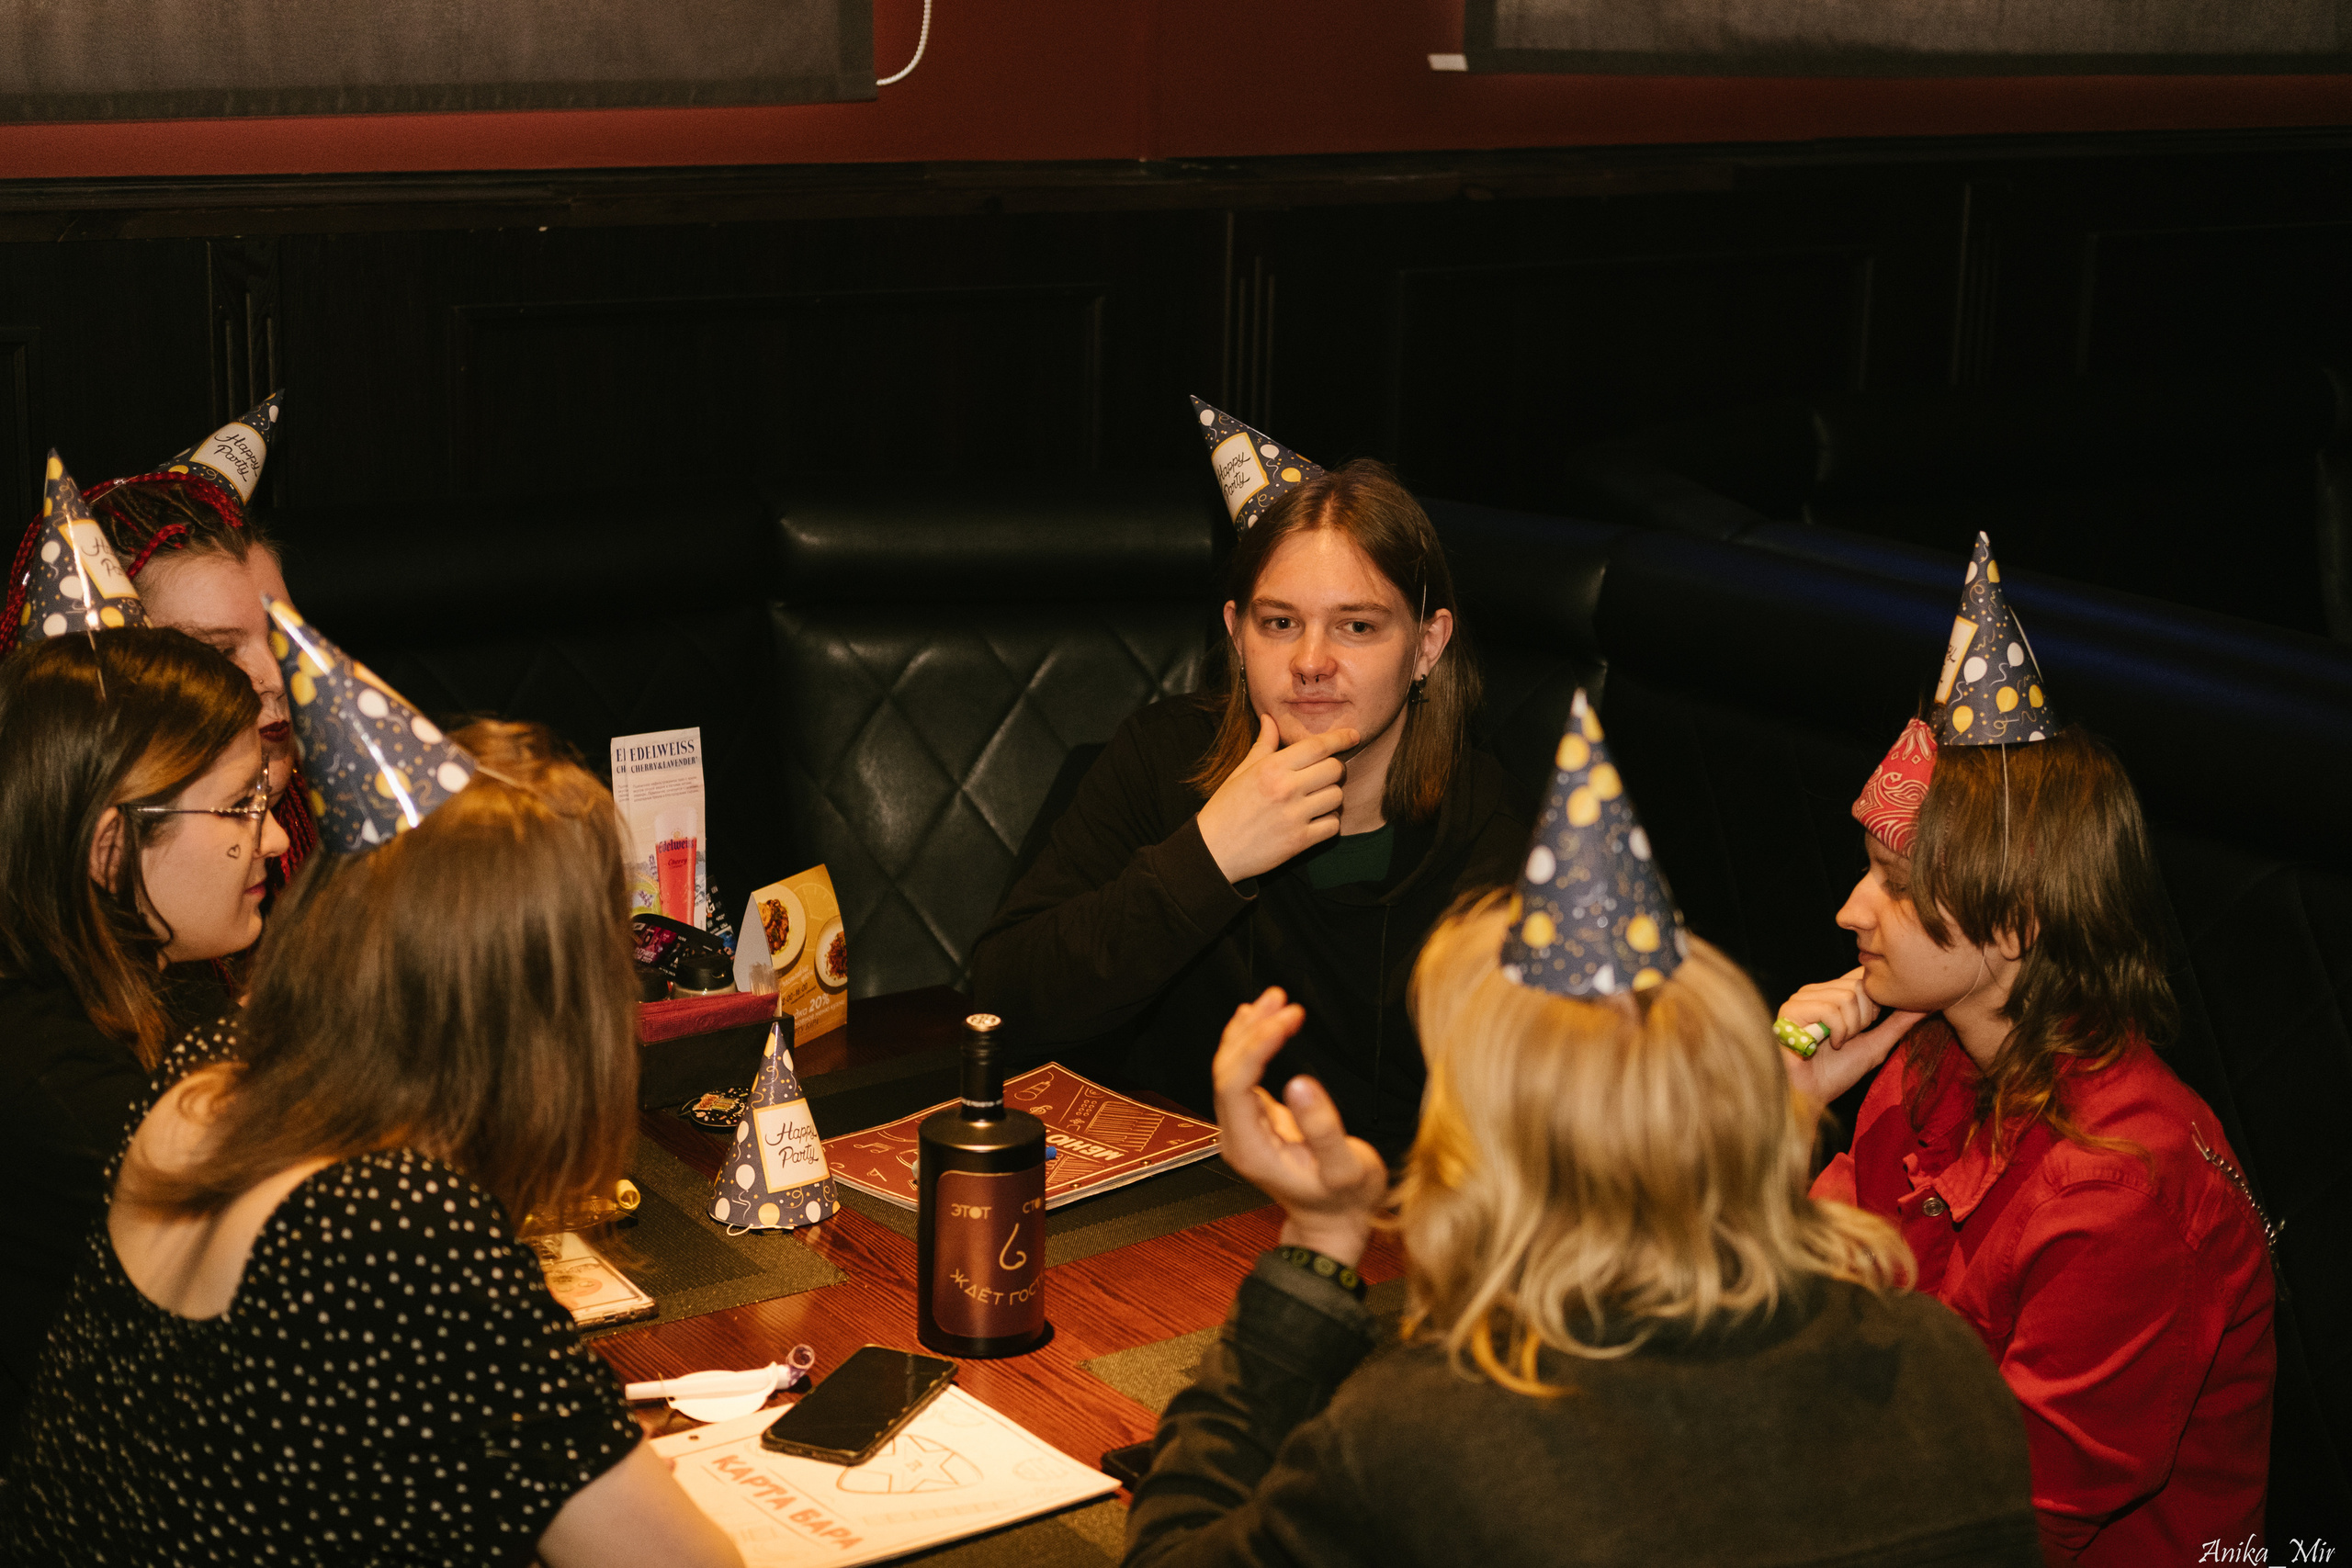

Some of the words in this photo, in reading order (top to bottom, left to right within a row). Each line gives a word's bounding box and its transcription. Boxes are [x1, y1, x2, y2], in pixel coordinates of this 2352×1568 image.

[213, 445, 249, 482] Party
[214, 434, 260, 478] Happy
[1216, 451, 1251, 489] Happy
[1223, 471, 1250, 504] Party
[629, 739, 695, 762] EDELWEISS
[808, 993, 831, 1012] 20%
[764, 1121, 818, 1146] Happy
[778, 1144, 820, 1169] Party
[1046, 1134, 1125, 1161] МЕНЮ
[950, 1202, 992, 1220] ЭТОТ
[711, 1454, 797, 1511] КАРТА
[788, 1507, 865, 1551] БАРА
